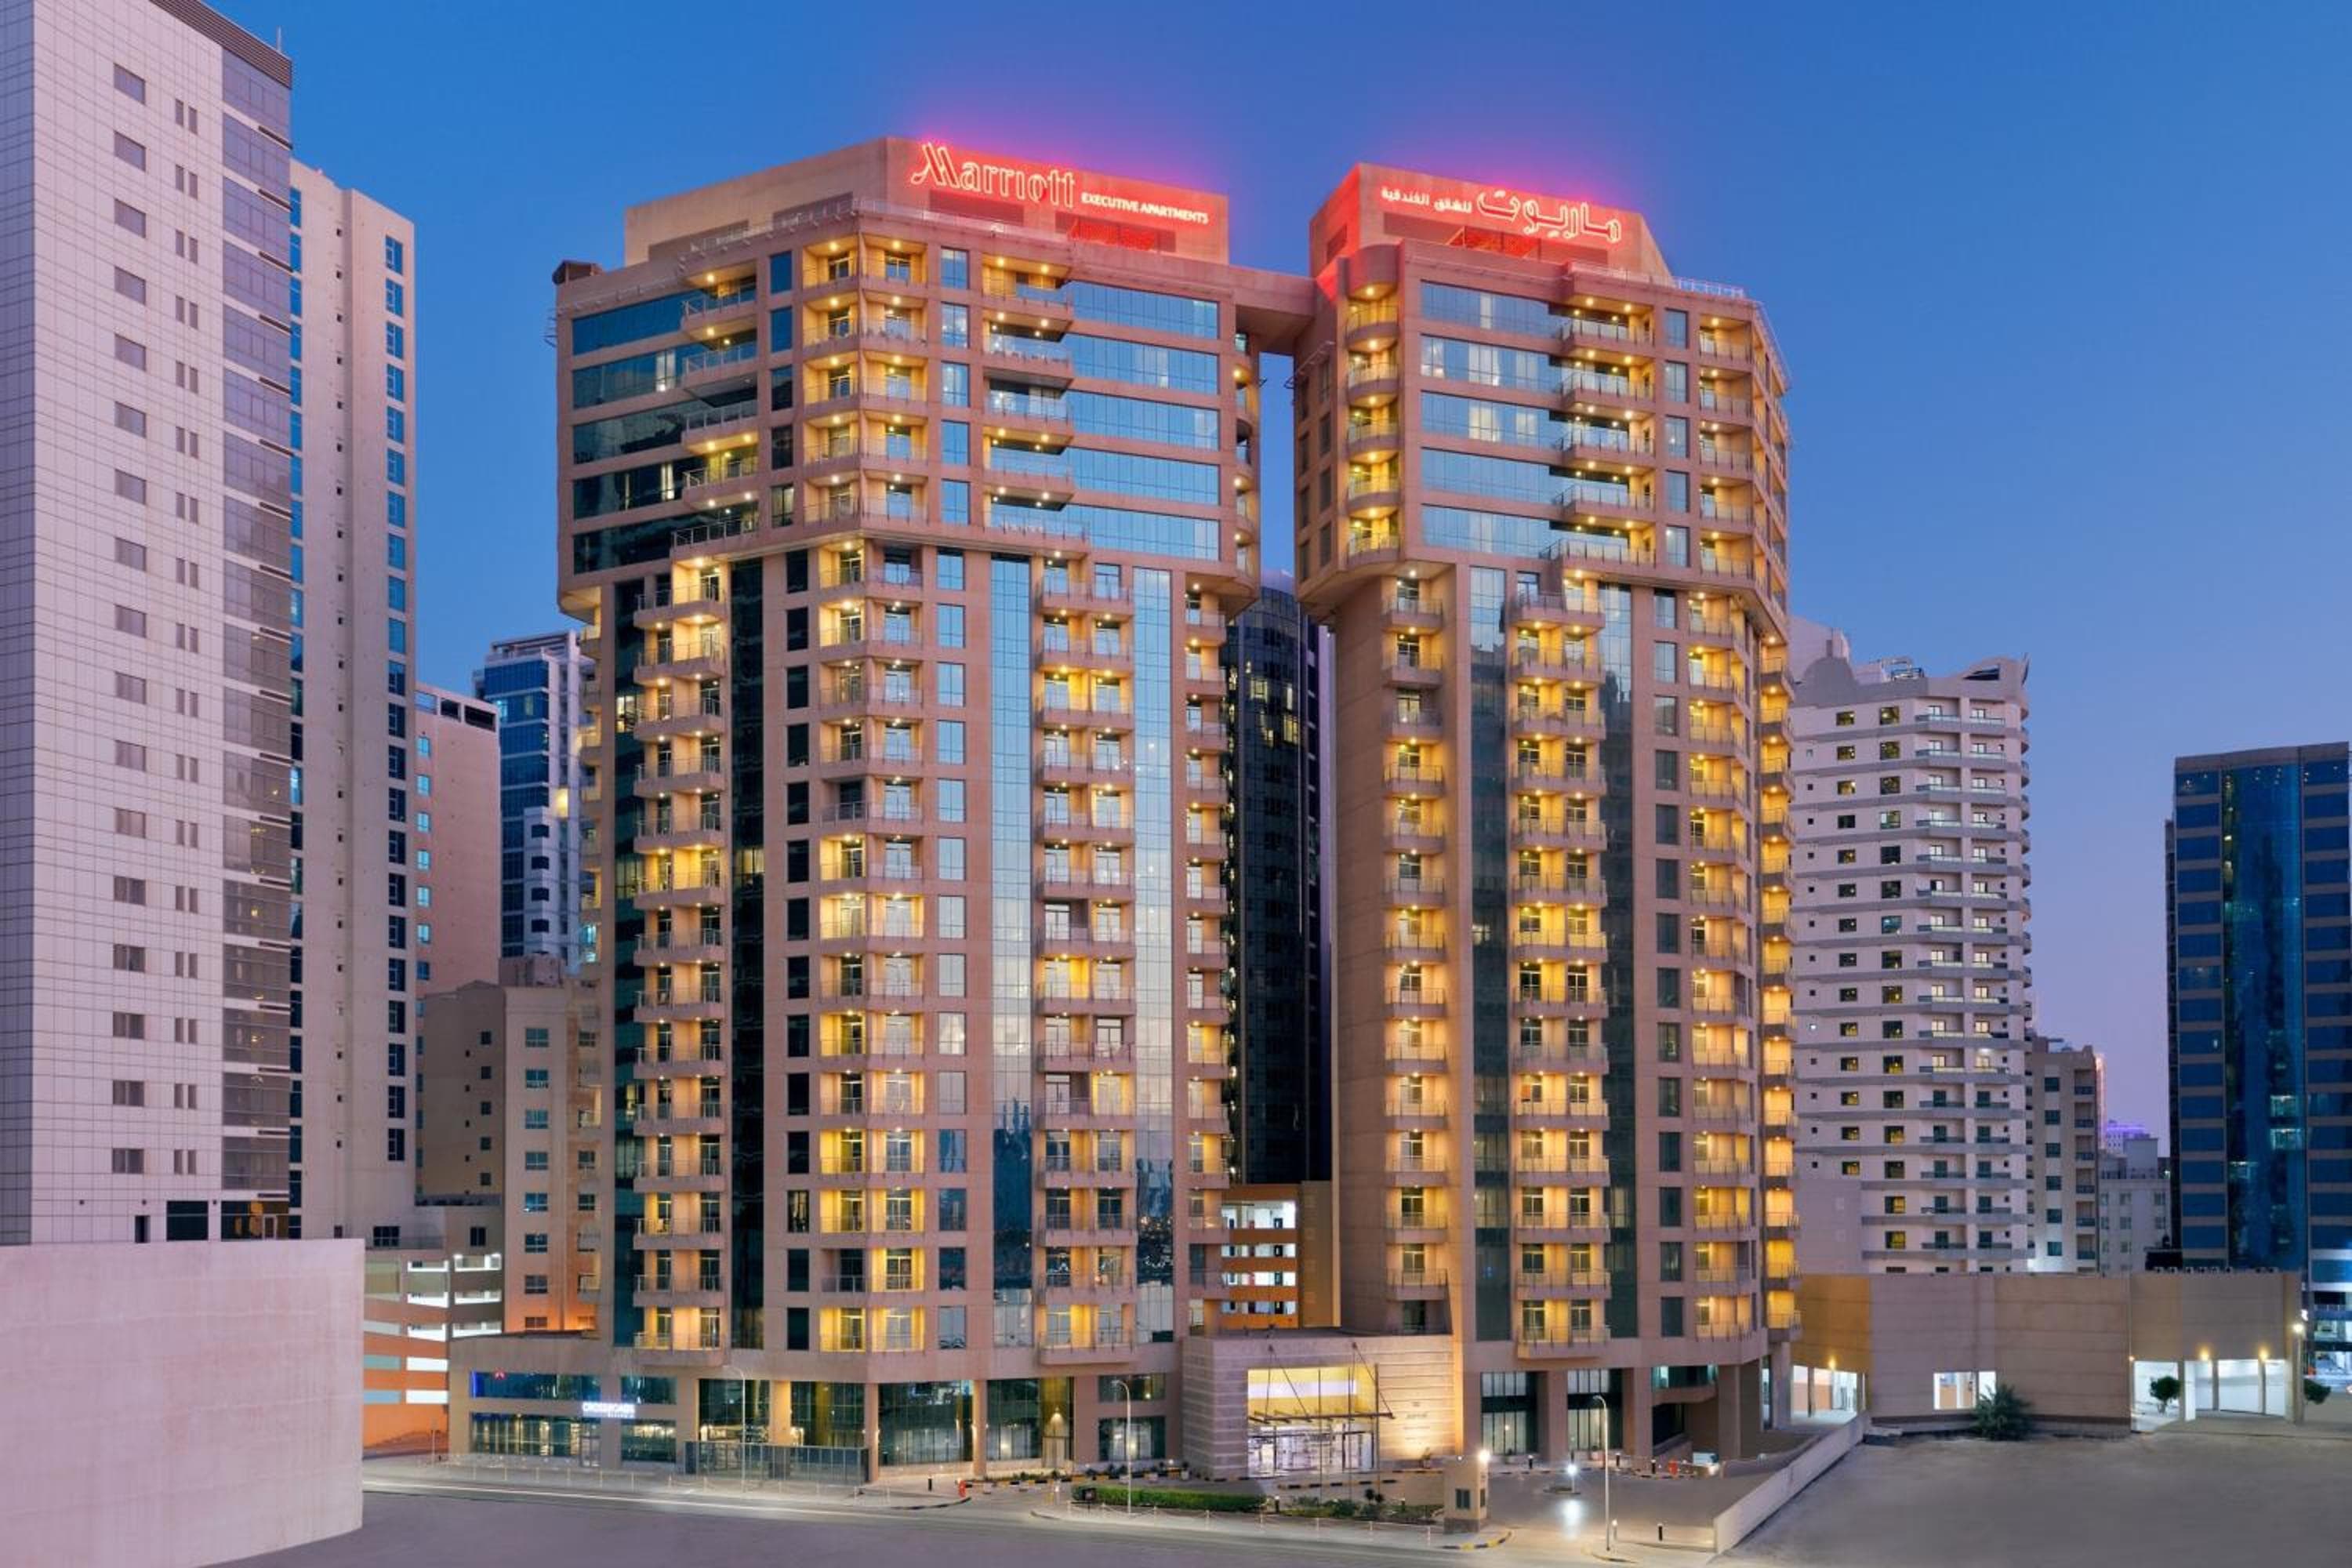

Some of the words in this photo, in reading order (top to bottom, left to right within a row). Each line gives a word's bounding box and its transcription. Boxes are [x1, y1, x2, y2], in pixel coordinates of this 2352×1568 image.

[910, 142, 1075, 209] Marriott
[1081, 192, 1139, 212] EXECUTIVE
[1140, 203, 1209, 224] APARTMENTS
[1477, 190, 1621, 242] ماريوت
